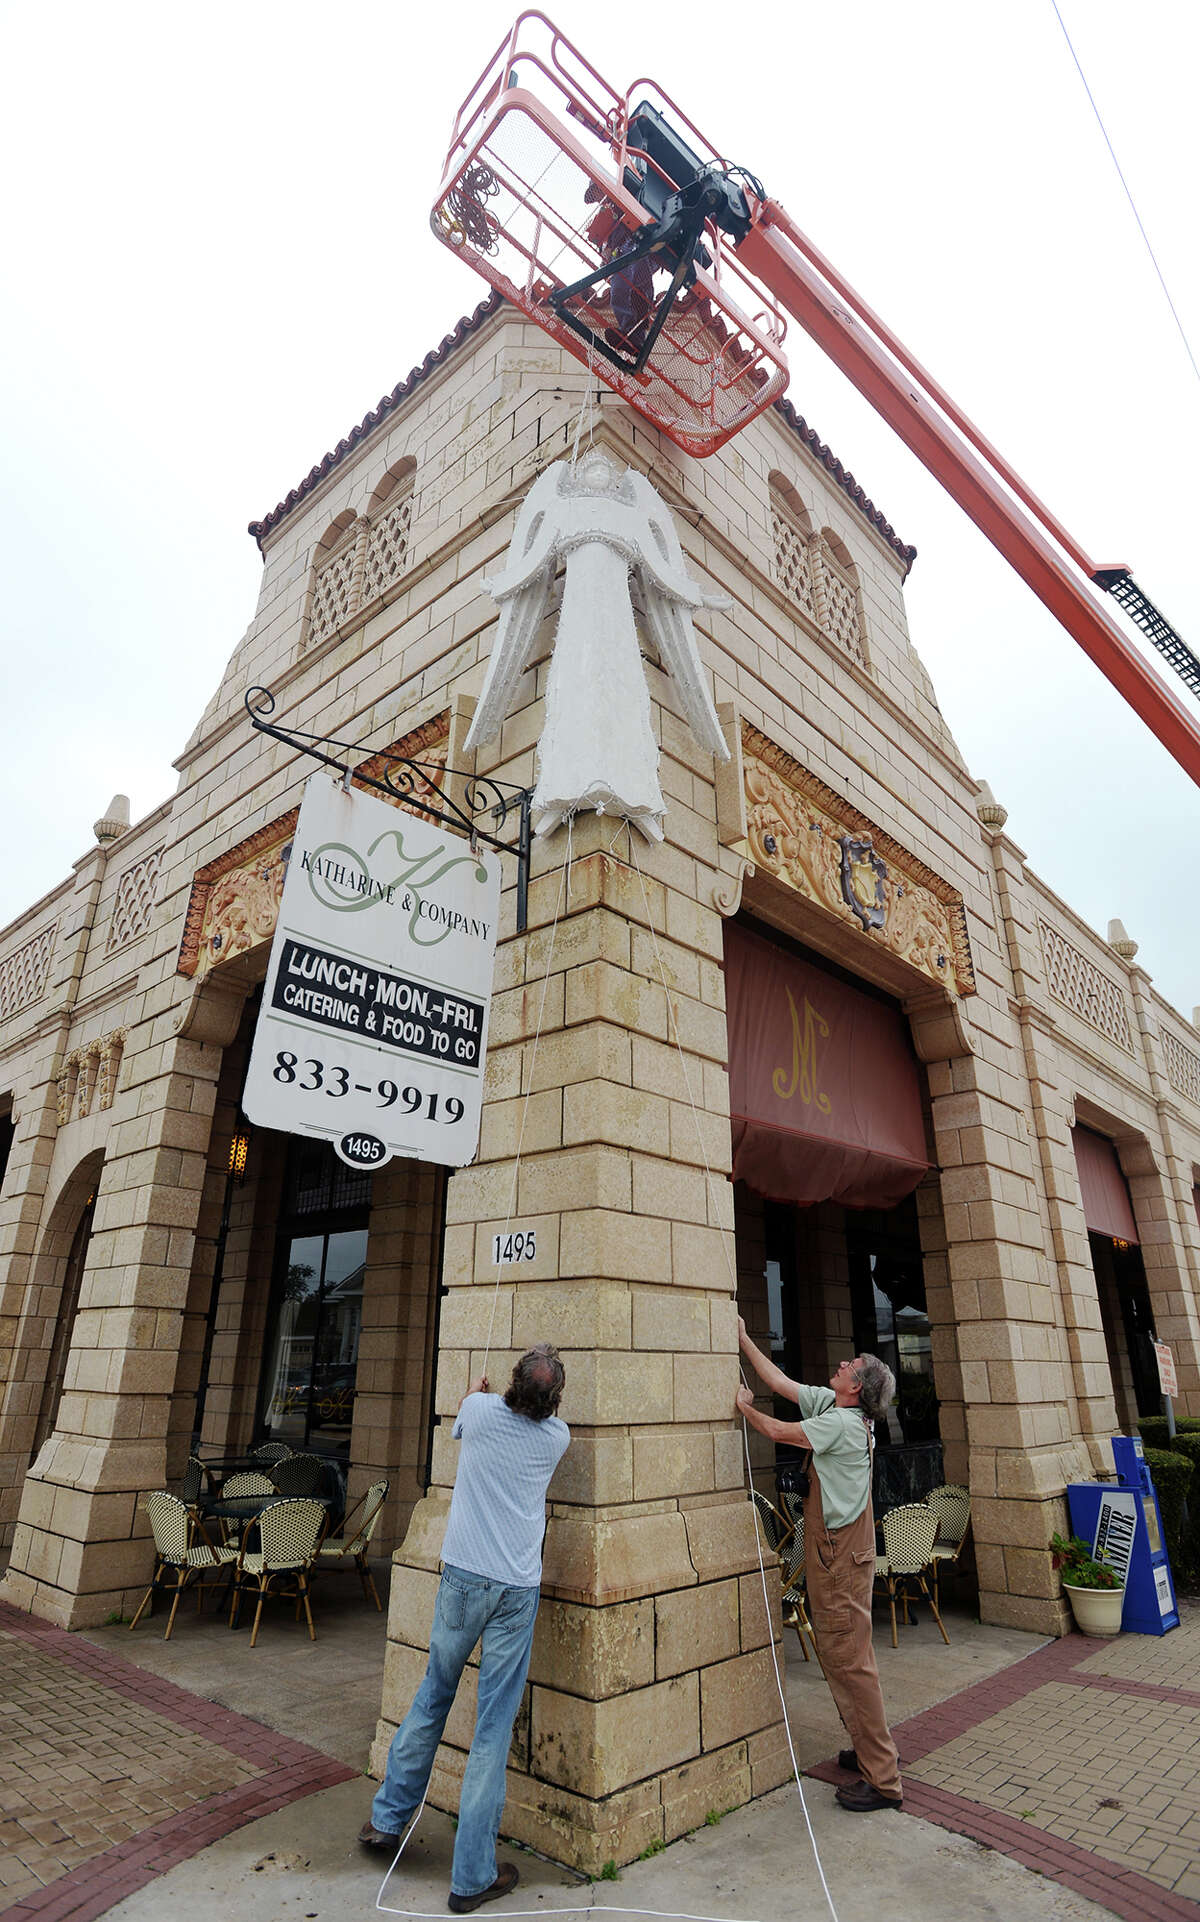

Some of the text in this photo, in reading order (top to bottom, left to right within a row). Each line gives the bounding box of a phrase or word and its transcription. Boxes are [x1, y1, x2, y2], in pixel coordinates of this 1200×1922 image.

[300, 850, 490, 940] KATHARINE & COMPANY
[283, 983, 477, 1060] CATERING & FOOD TO GO
[272, 1051, 465, 1125] 833-9919
[346, 1136, 381, 1160] 1495
[495, 1231, 536, 1264] 1495
